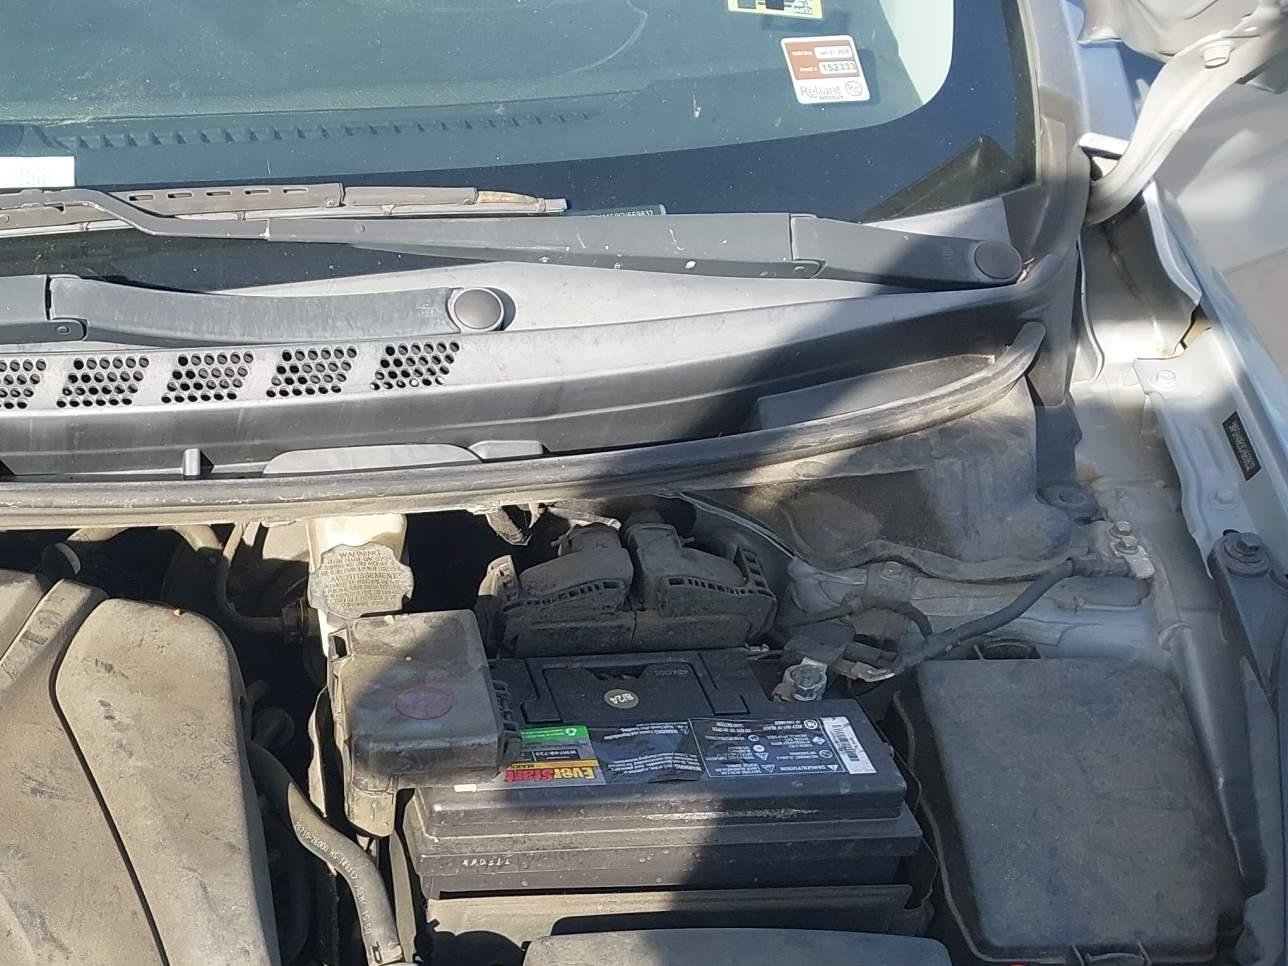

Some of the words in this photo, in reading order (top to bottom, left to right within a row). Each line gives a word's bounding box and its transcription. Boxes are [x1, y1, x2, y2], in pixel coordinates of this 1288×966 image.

[822, 63, 857, 73] 152333
[800, 82, 842, 99] Reliant
[339, 550, 381, 559] WARNING
[609, 692, 635, 706] 8/24
[503, 766, 596, 784] EverStart
